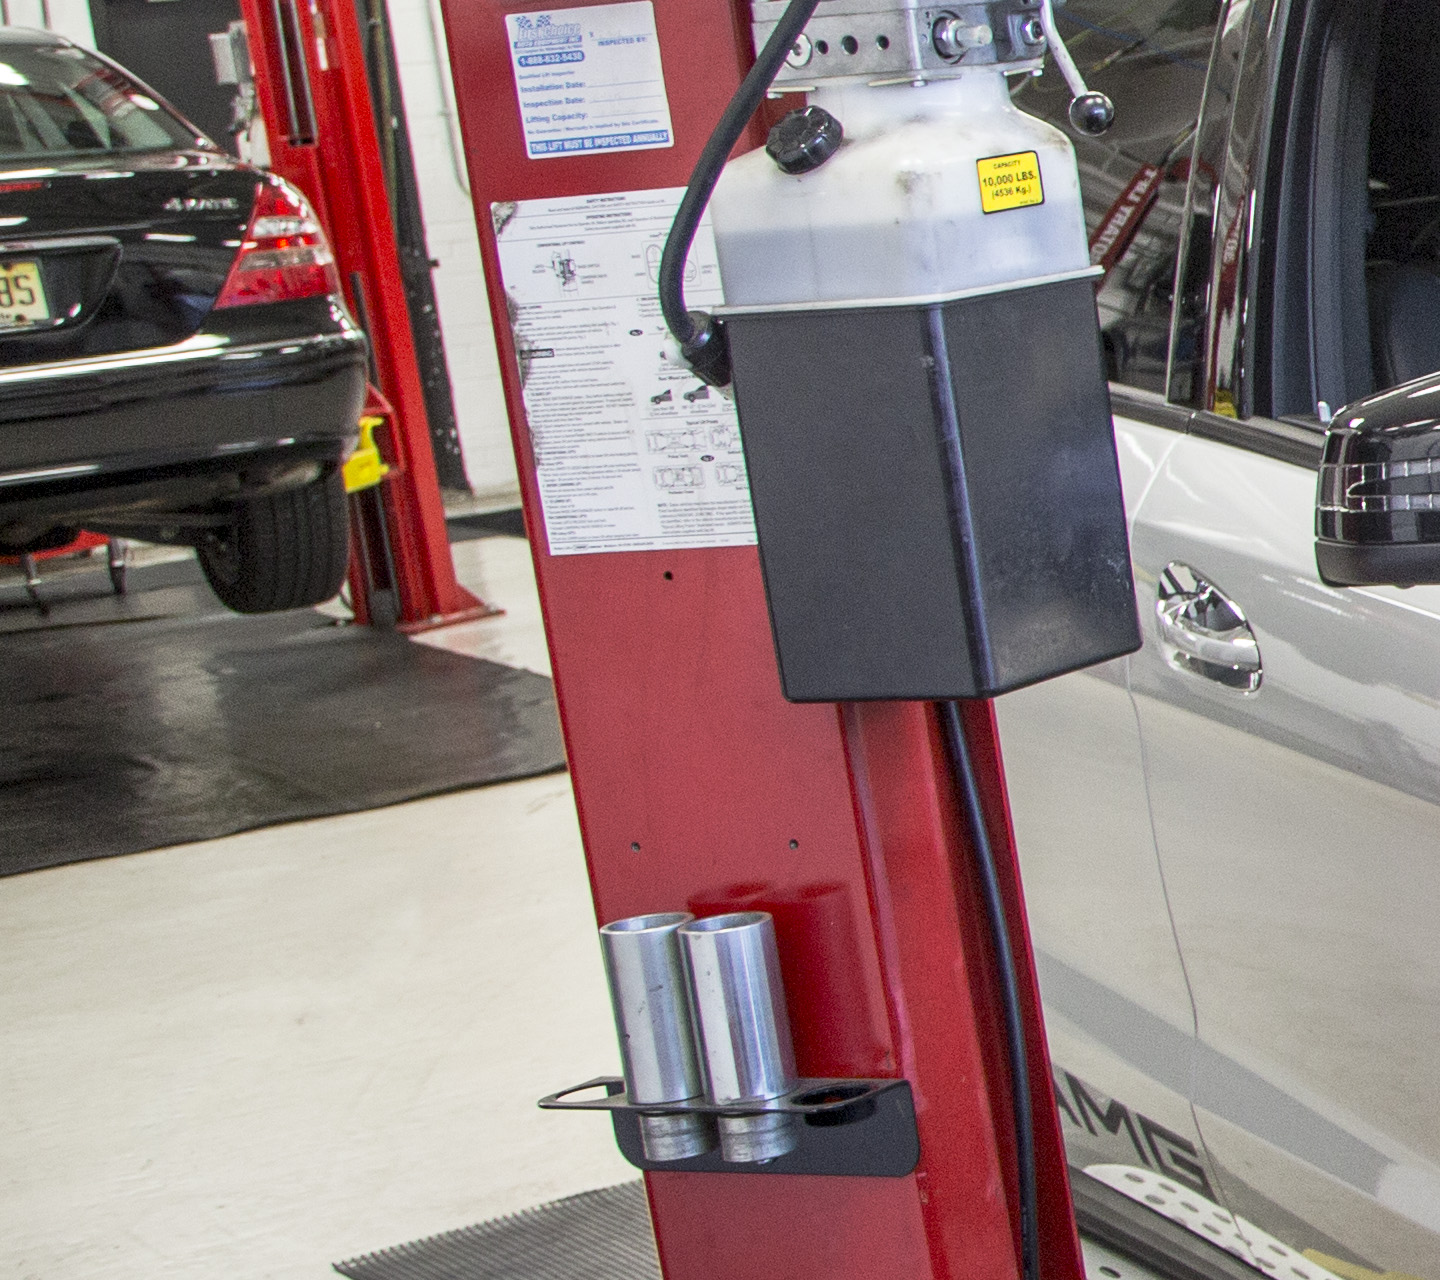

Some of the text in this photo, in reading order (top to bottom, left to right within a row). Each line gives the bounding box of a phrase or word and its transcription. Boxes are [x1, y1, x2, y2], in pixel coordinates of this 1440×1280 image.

[542, 21, 582, 38] Choice
[520, 81, 586, 93] Installation Date:
[523, 97, 586, 108] Inspection Date:
[526, 112, 588, 124] Lifting Capacity:
[531, 142, 548, 152] THIS
[549, 141, 563, 151] LIFT
[564, 139, 582, 149] MUST
[584, 138, 593, 148] BE
[595, 134, 631, 147] INSPECTED
[993, 160, 1021, 169] CAPACITY
[983, 170, 1037, 187] 10,000 LBS.
